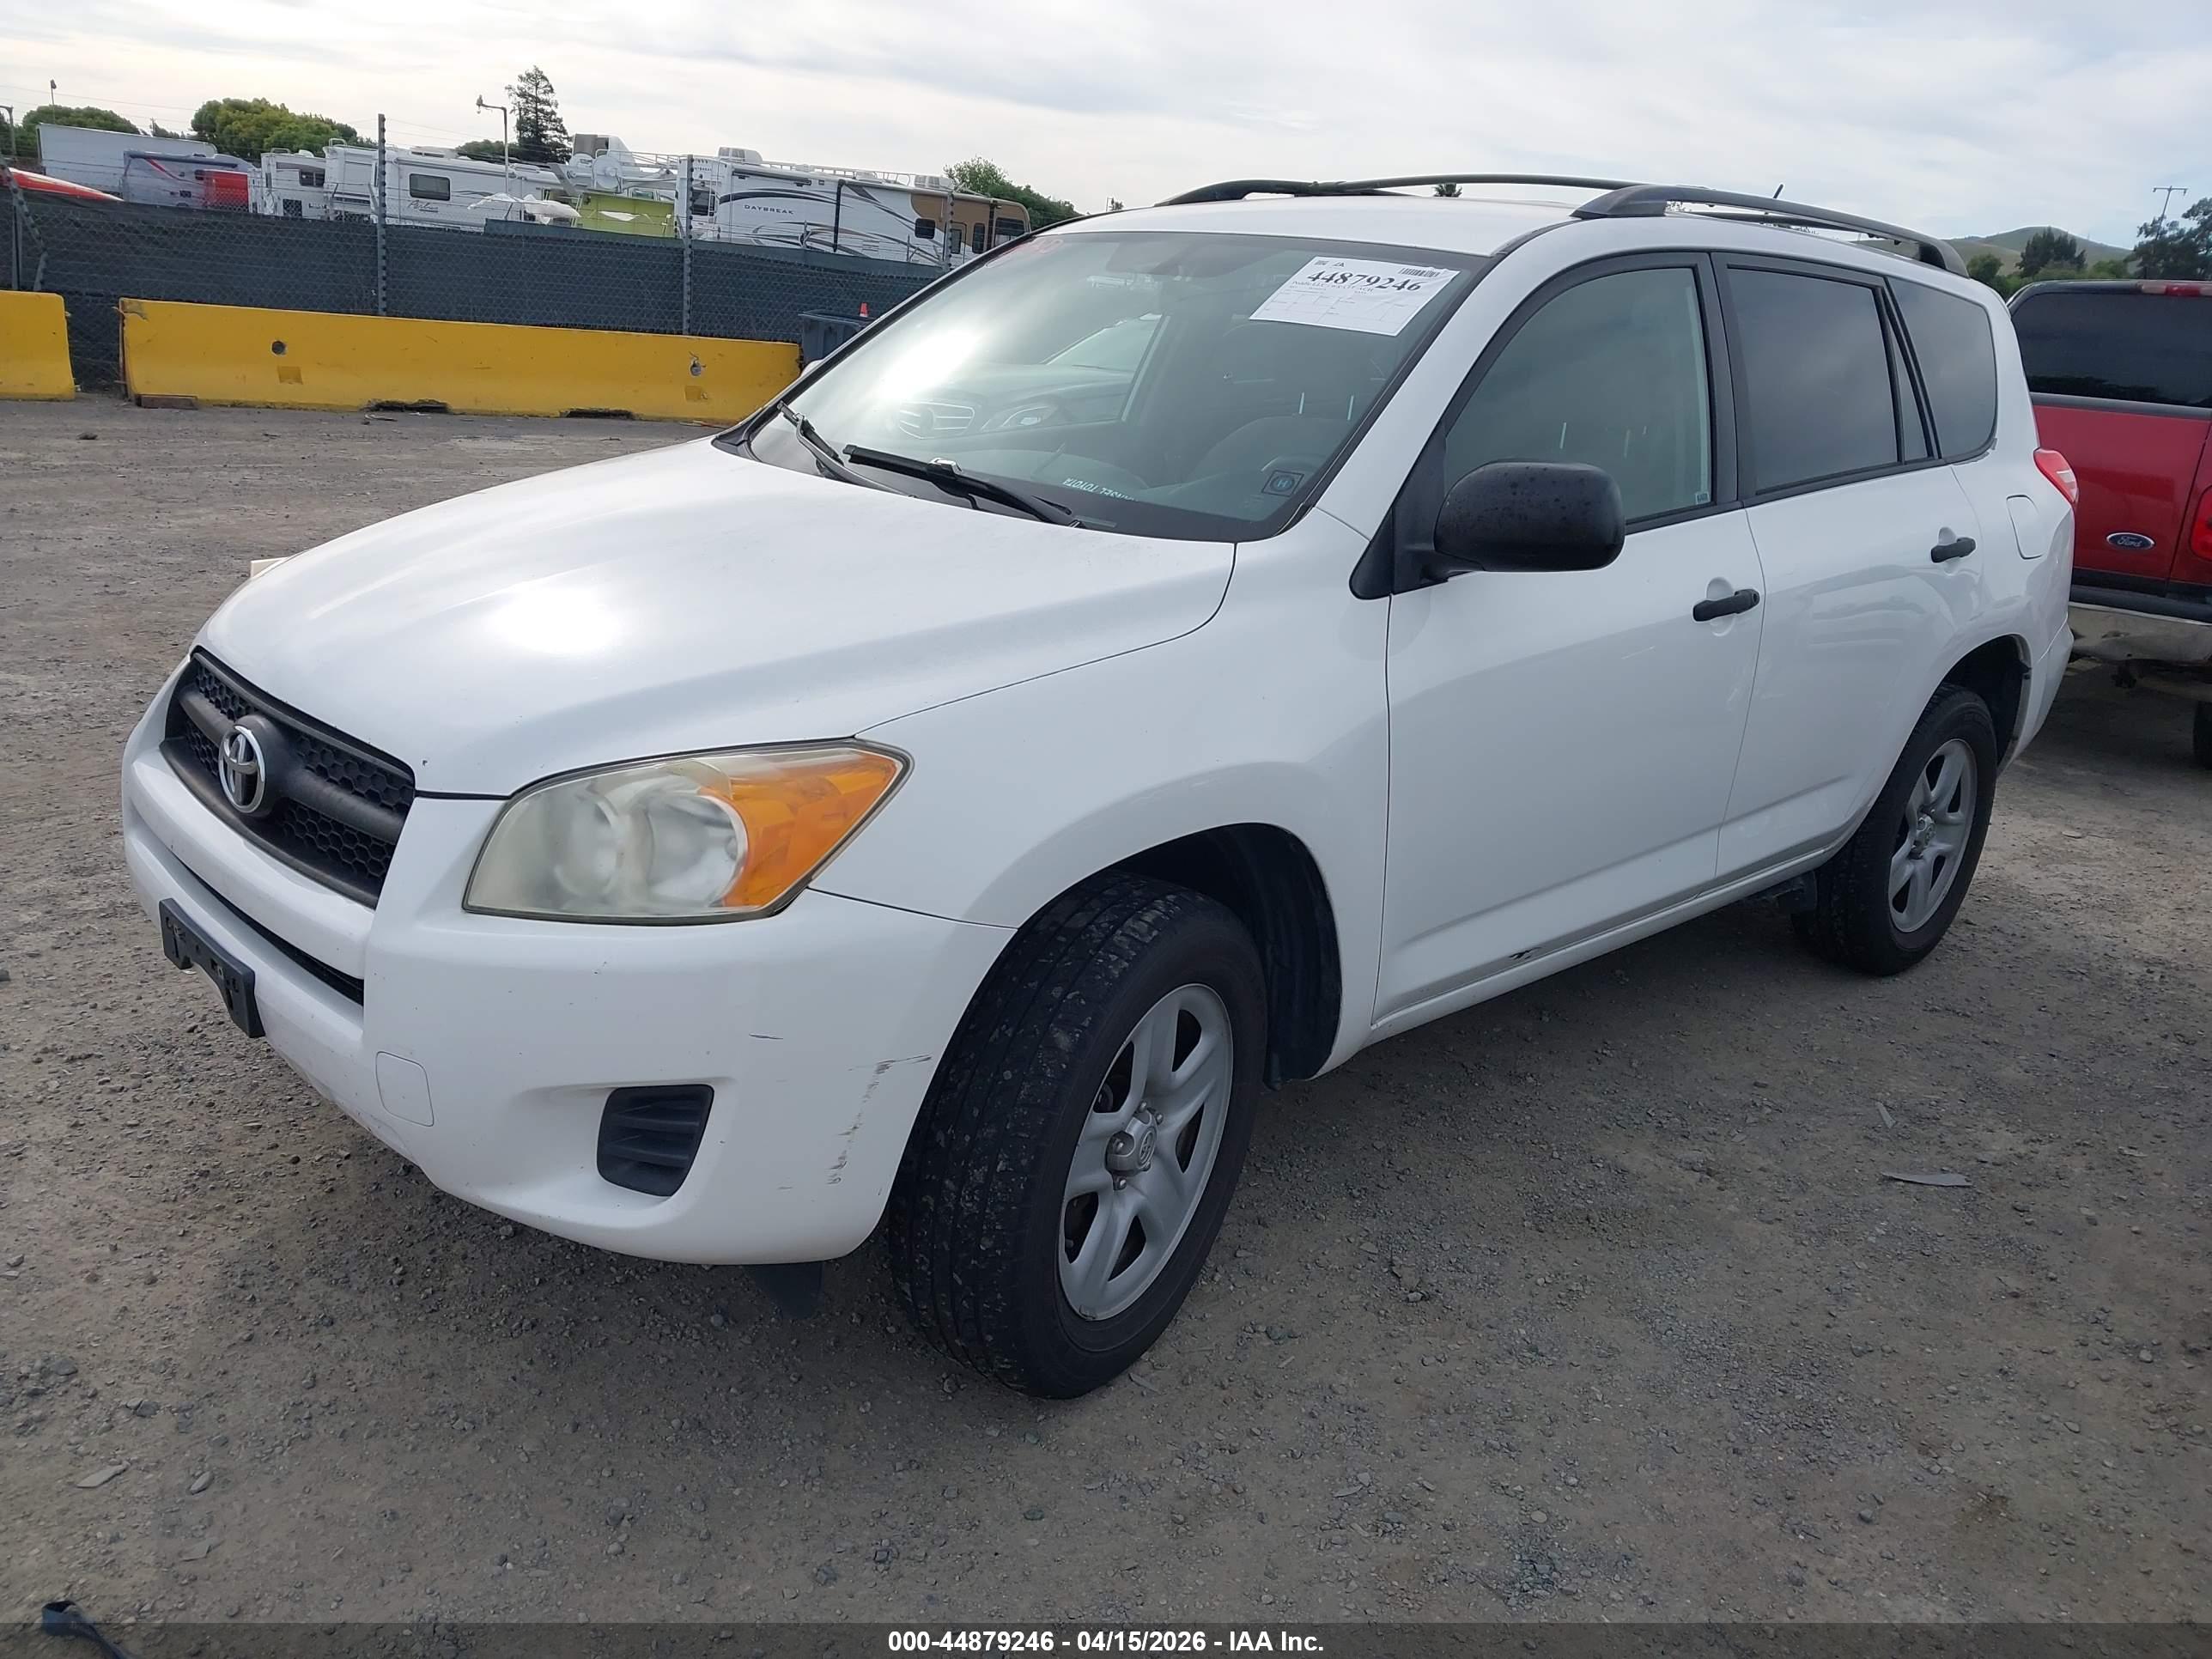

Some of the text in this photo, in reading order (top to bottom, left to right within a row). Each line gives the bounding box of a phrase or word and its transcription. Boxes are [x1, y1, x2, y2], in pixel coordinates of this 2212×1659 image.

[744, 204, 794, 215] DAYBREAK
[1306, 270, 1425, 292] 44879246
[1062, 477, 1100, 493] TOYOTA
[2117, 535, 2142, 547] Ford
